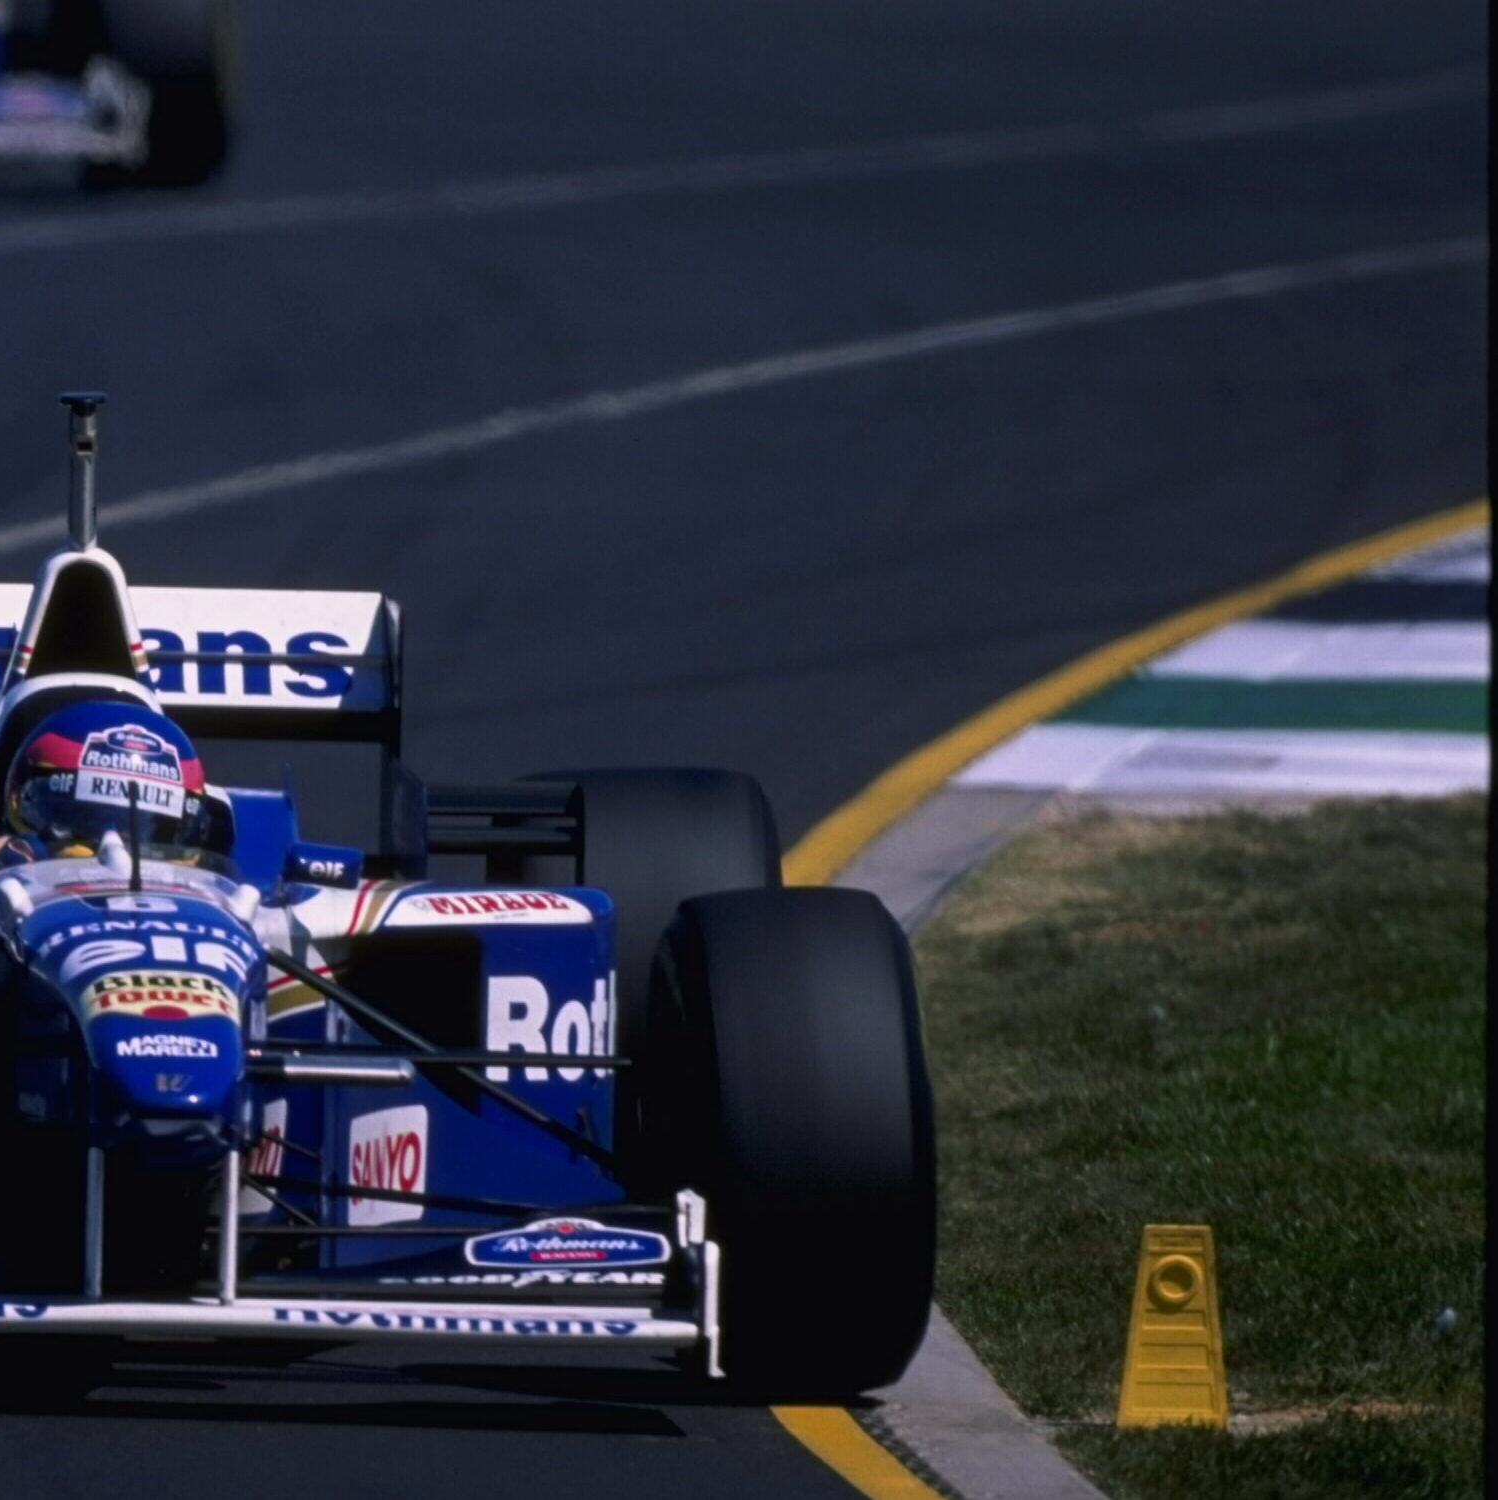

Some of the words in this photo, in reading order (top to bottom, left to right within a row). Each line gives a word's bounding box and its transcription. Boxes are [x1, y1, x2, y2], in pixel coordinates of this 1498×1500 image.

[86, 751, 178, 779] Rothmans
[93, 974, 227, 998] Black
[351, 1131, 420, 1206] SANYO
